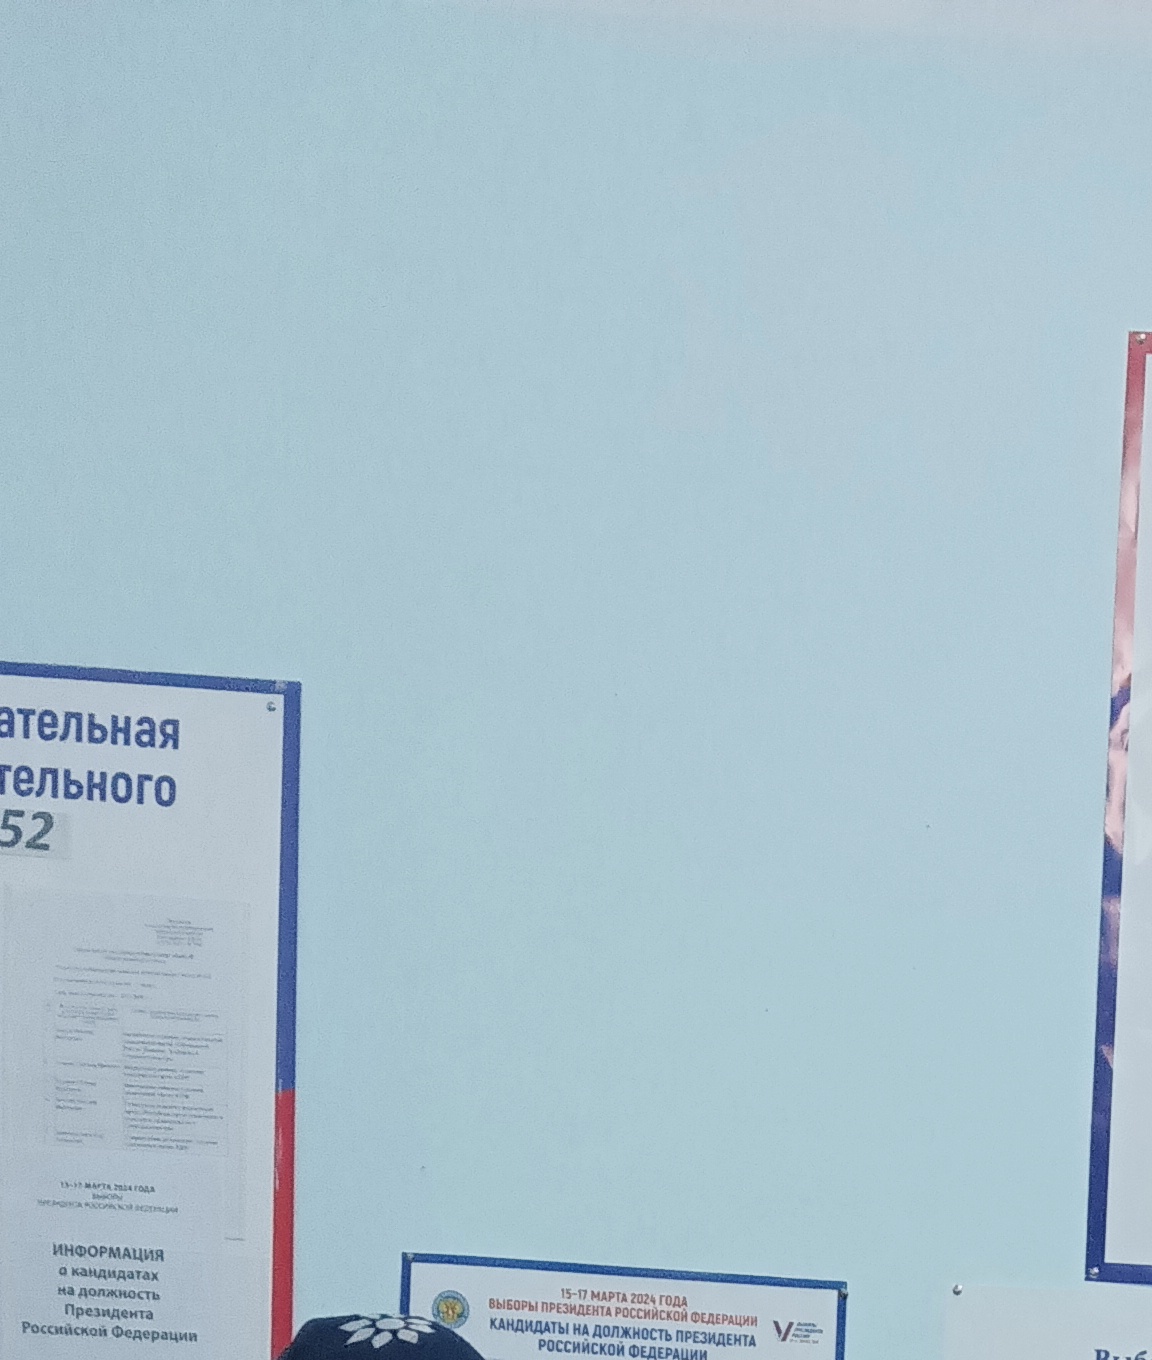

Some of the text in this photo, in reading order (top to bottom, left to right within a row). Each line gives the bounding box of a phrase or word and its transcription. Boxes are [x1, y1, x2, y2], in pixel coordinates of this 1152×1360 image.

[0, 706, 181, 750] ательная
[0, 764, 177, 807] тельного
[0, 809, 54, 851] 52
[52, 1243, 165, 1263] ИНФОРМАЦИЯ
[59, 1266, 159, 1282] о кандидатах
[57, 1286, 161, 1301] на должность
[590, 1290, 628, 1304] МАРТА
[630, 1293, 656, 1306] 2024
[659, 1295, 688, 1308] ГОДА
[64, 1303, 154, 1320] Президента
[489, 1298, 758, 1328] ВЫБОРЫ ПРЕЗИДЕНТА РОССИЙСКОЙ ФЕДЕРАЦИИ
[21, 1320, 198, 1343] Российской Федерации
[490, 1317, 757, 1348] КАНДИДАТЫ НА ДОЛЖНОСТЬ ПРЕЗИДЕНТА
[538, 1338, 625, 1357] РОССИЙСКОЙ
